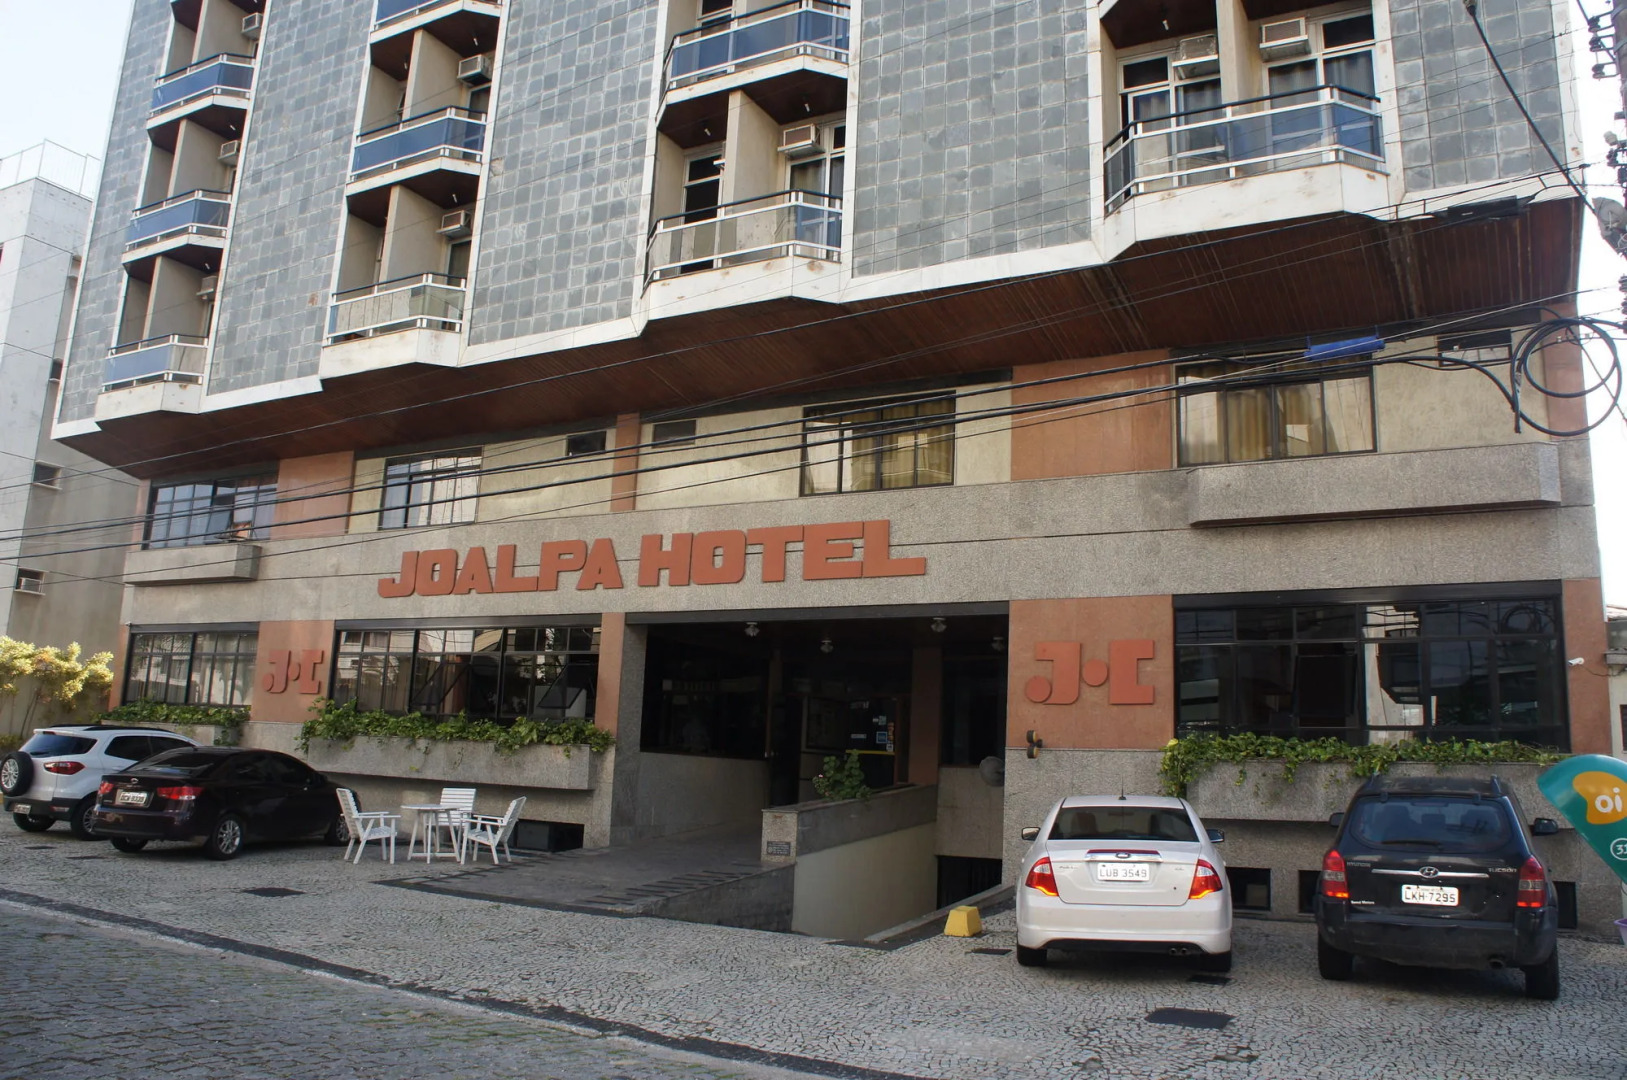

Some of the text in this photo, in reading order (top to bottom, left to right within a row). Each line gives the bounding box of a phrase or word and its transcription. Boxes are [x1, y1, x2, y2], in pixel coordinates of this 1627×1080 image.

[378, 519, 926, 598] JOALPA HOTEL
[1594, 786, 1623, 813] oi
[1099, 868, 1148, 878] LUB 3549
